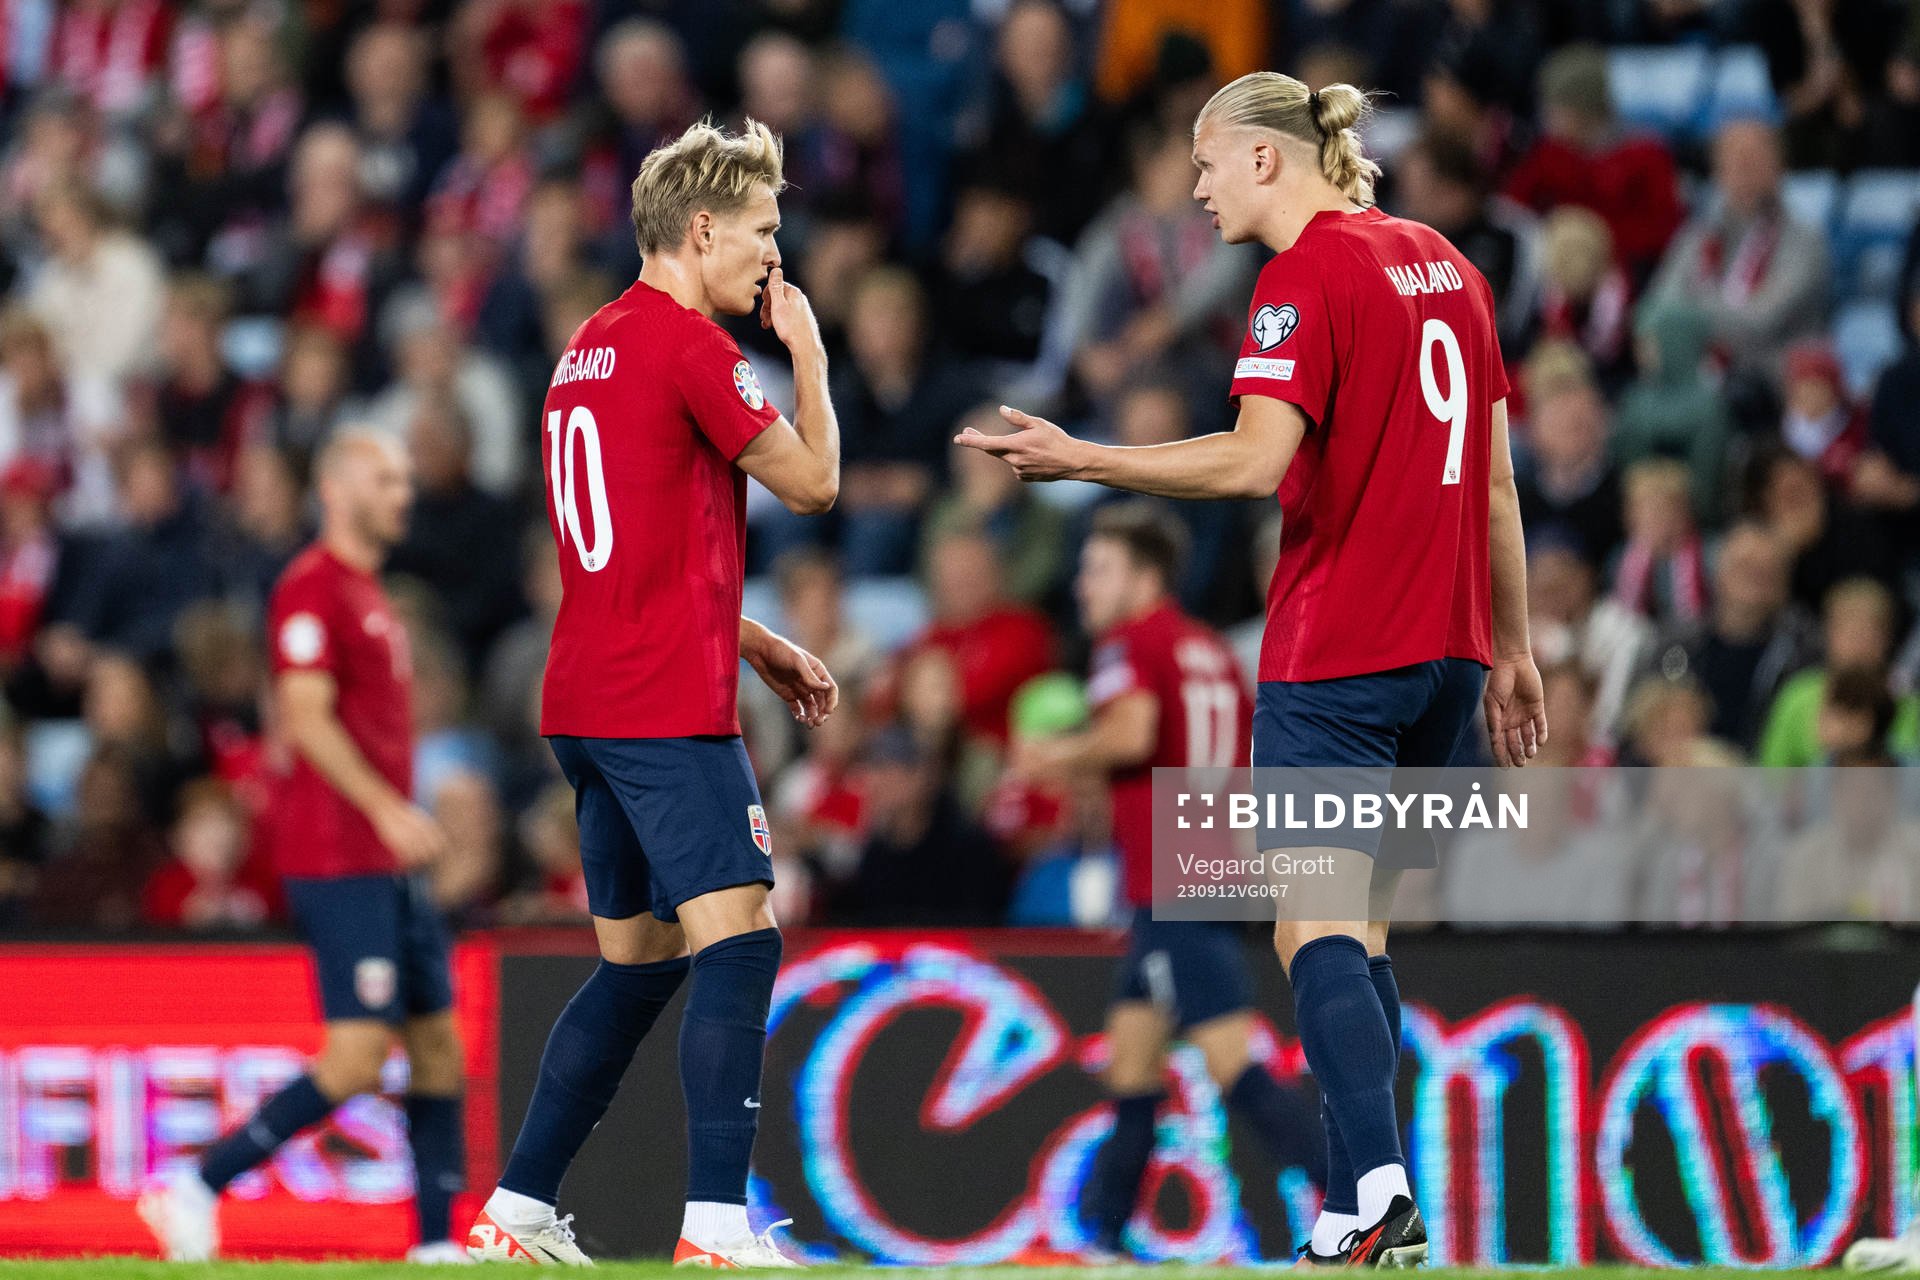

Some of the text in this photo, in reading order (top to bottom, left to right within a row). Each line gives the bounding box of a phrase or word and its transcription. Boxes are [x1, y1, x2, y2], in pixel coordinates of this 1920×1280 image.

[1384, 260, 1463, 296] HAALAND
[1419, 318, 1468, 486] 9
[547, 405, 614, 573] 10
